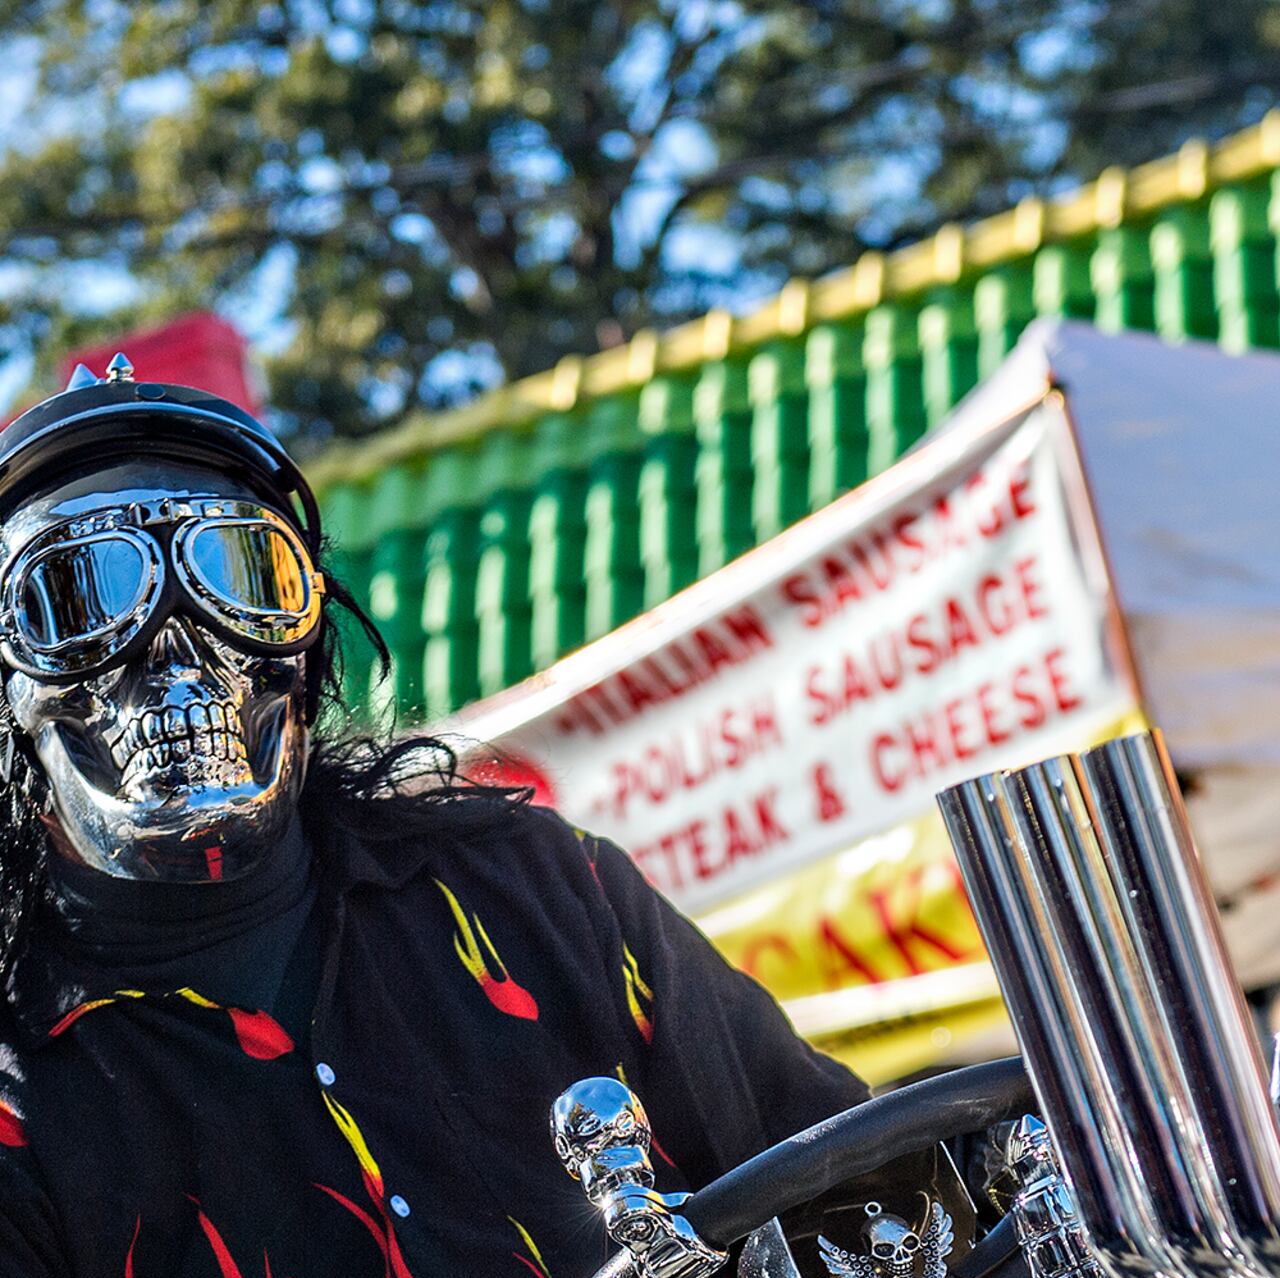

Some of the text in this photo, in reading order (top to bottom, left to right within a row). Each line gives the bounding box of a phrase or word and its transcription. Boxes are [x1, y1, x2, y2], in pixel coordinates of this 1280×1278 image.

[806, 556, 1048, 725] SAUSAGE
[813, 761, 845, 822] &
[871, 649, 1086, 793] CHEESE
